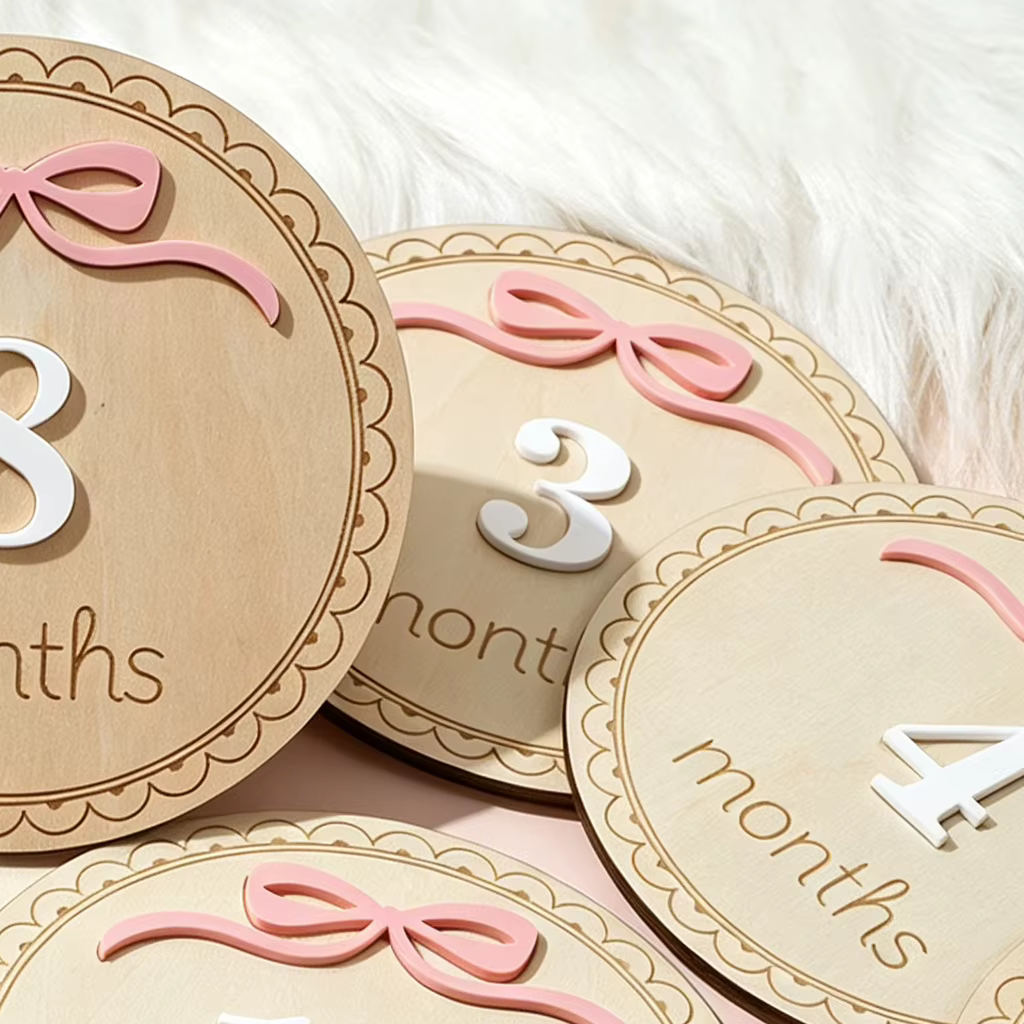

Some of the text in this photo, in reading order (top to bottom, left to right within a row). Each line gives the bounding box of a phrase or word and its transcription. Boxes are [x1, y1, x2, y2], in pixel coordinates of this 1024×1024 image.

[476, 417, 631, 573] 3
[376, 591, 568, 685] ont
[672, 738, 928, 971] months
[870, 724, 1024, 849] 4
